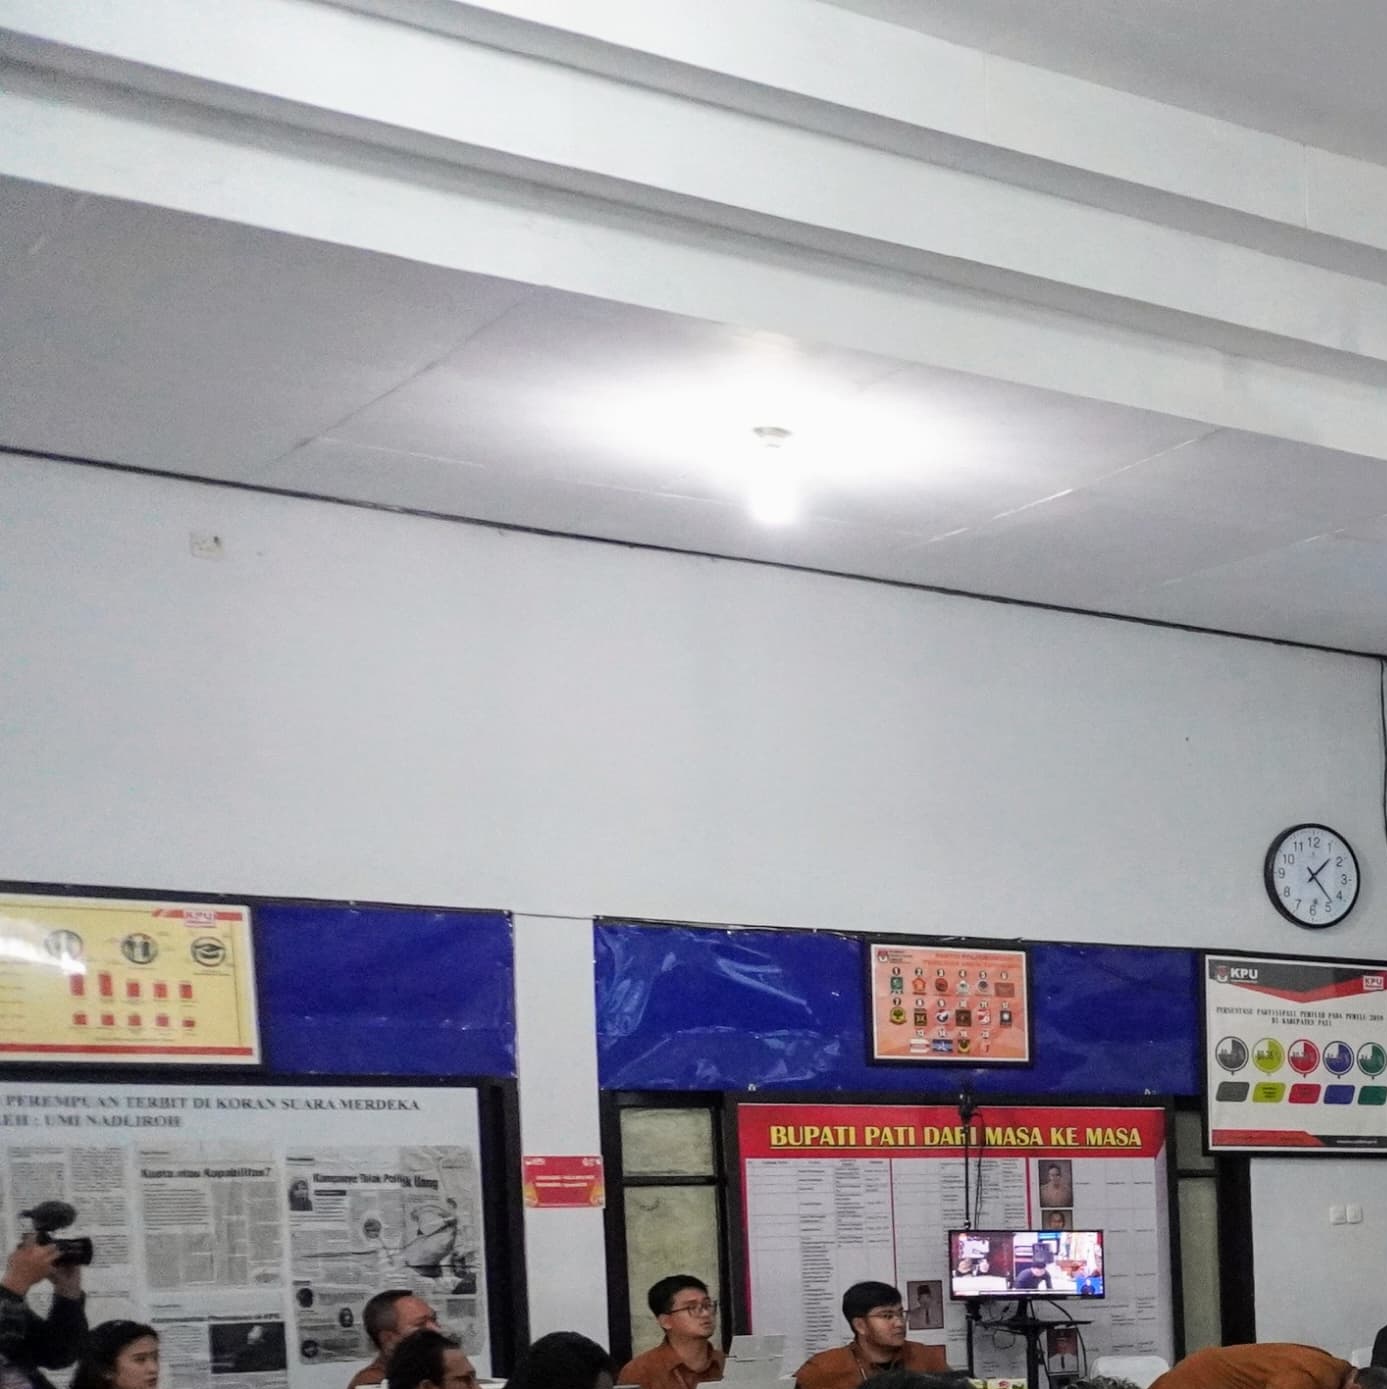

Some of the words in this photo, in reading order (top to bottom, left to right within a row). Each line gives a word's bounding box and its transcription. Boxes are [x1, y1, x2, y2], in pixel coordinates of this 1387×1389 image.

[1294, 841, 1303, 852] 11
[1308, 837, 1320, 848] 12
[1327, 842, 1332, 853] 1
[1283, 854, 1295, 864] 10
[1336, 856, 1343, 867] 2
[1279, 867, 1285, 879] 9
[1341, 874, 1347, 885] 3
[1284, 886, 1290, 897] 8
[1336, 891, 1342, 900] 4
[1296, 899, 1302, 910] 7
[1310, 903, 1317, 916] 6
[1325, 902, 1331, 912] 5
[1230, 968, 1258, 979] KPU
[1365, 977, 1383, 986] KPU
[6, 1096, 120, 1108] PEREMPUAN
[125, 1097, 188, 1108] TERBIT
[192, 1098, 211, 1109] DI
[217, 1098, 275, 1110] KORAN
[339, 1099, 421, 1111] MERDEKA
[770, 1126, 855, 1145] BUPATI
[864, 1127, 915, 1145] PATI
[985, 1127, 1042, 1146] MASA
[1050, 1128, 1077, 1146] KE
[1085, 1128, 1141, 1147] MASA
